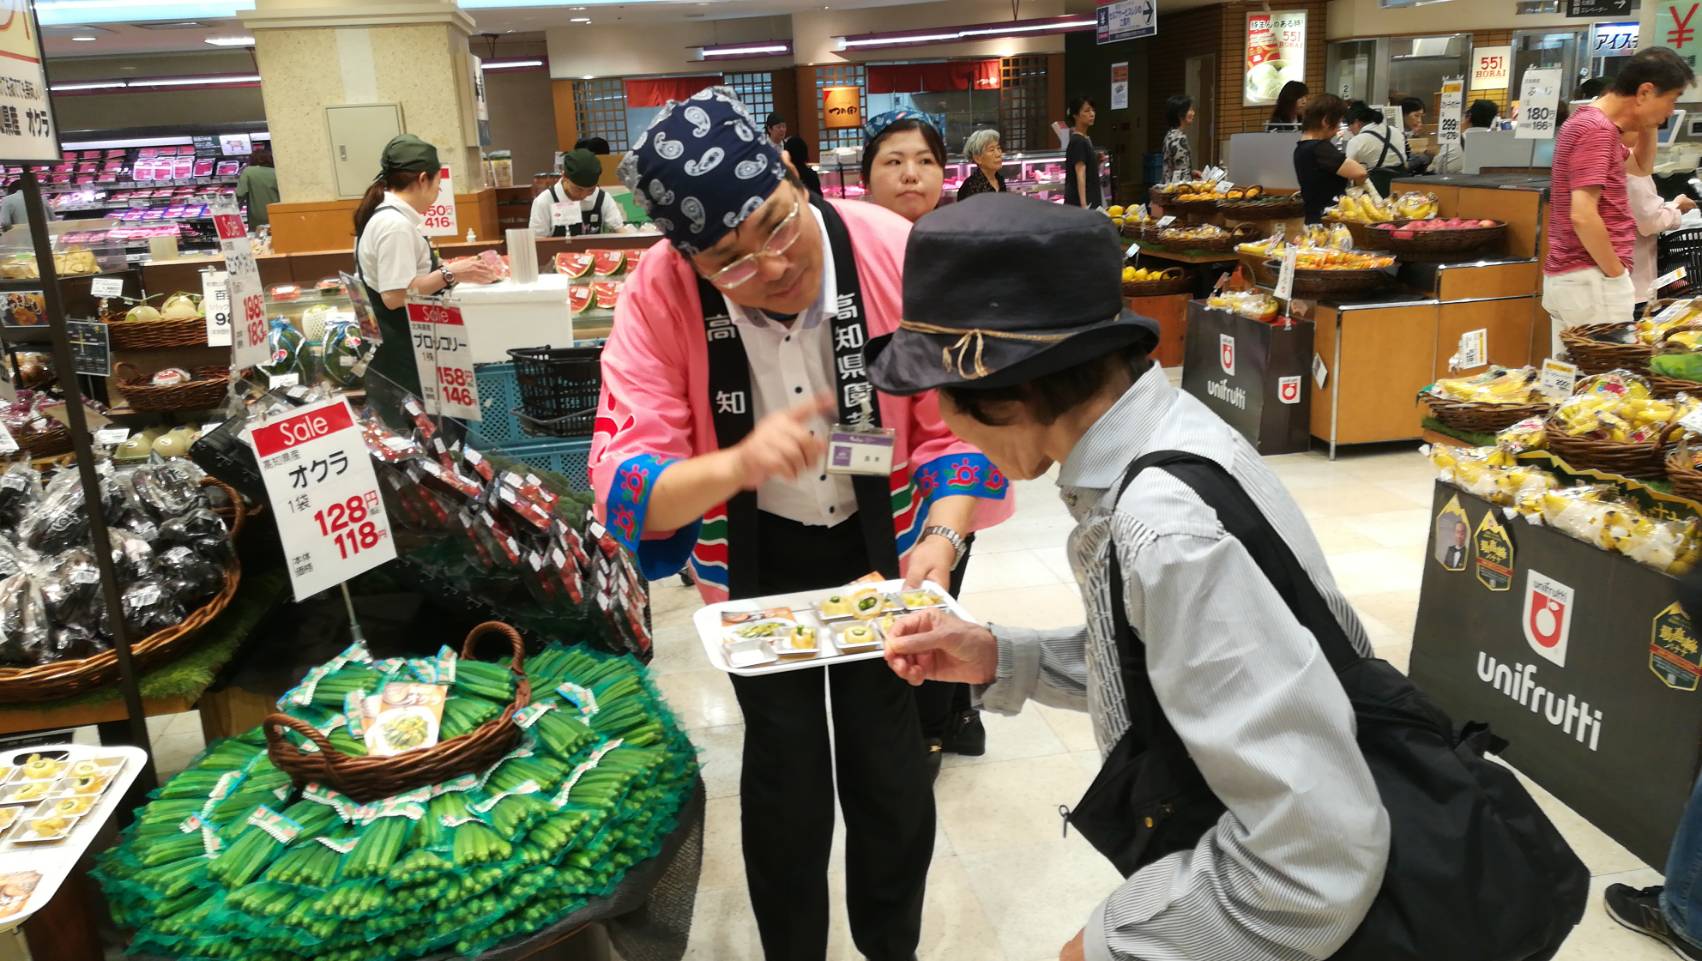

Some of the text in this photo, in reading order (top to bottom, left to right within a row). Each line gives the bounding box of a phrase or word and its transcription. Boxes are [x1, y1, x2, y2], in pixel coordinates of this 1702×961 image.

[1475, 70, 1506, 78] HORAI
[1481, 56, 1503, 70] 551
[1207, 378, 1247, 411] unifrutti
[279, 415, 329, 446] Sale
[289, 450, 349, 489] オクラ
[1532, 580, 1568, 604] unifrutti
[1476, 651, 1604, 752] unifrutti
